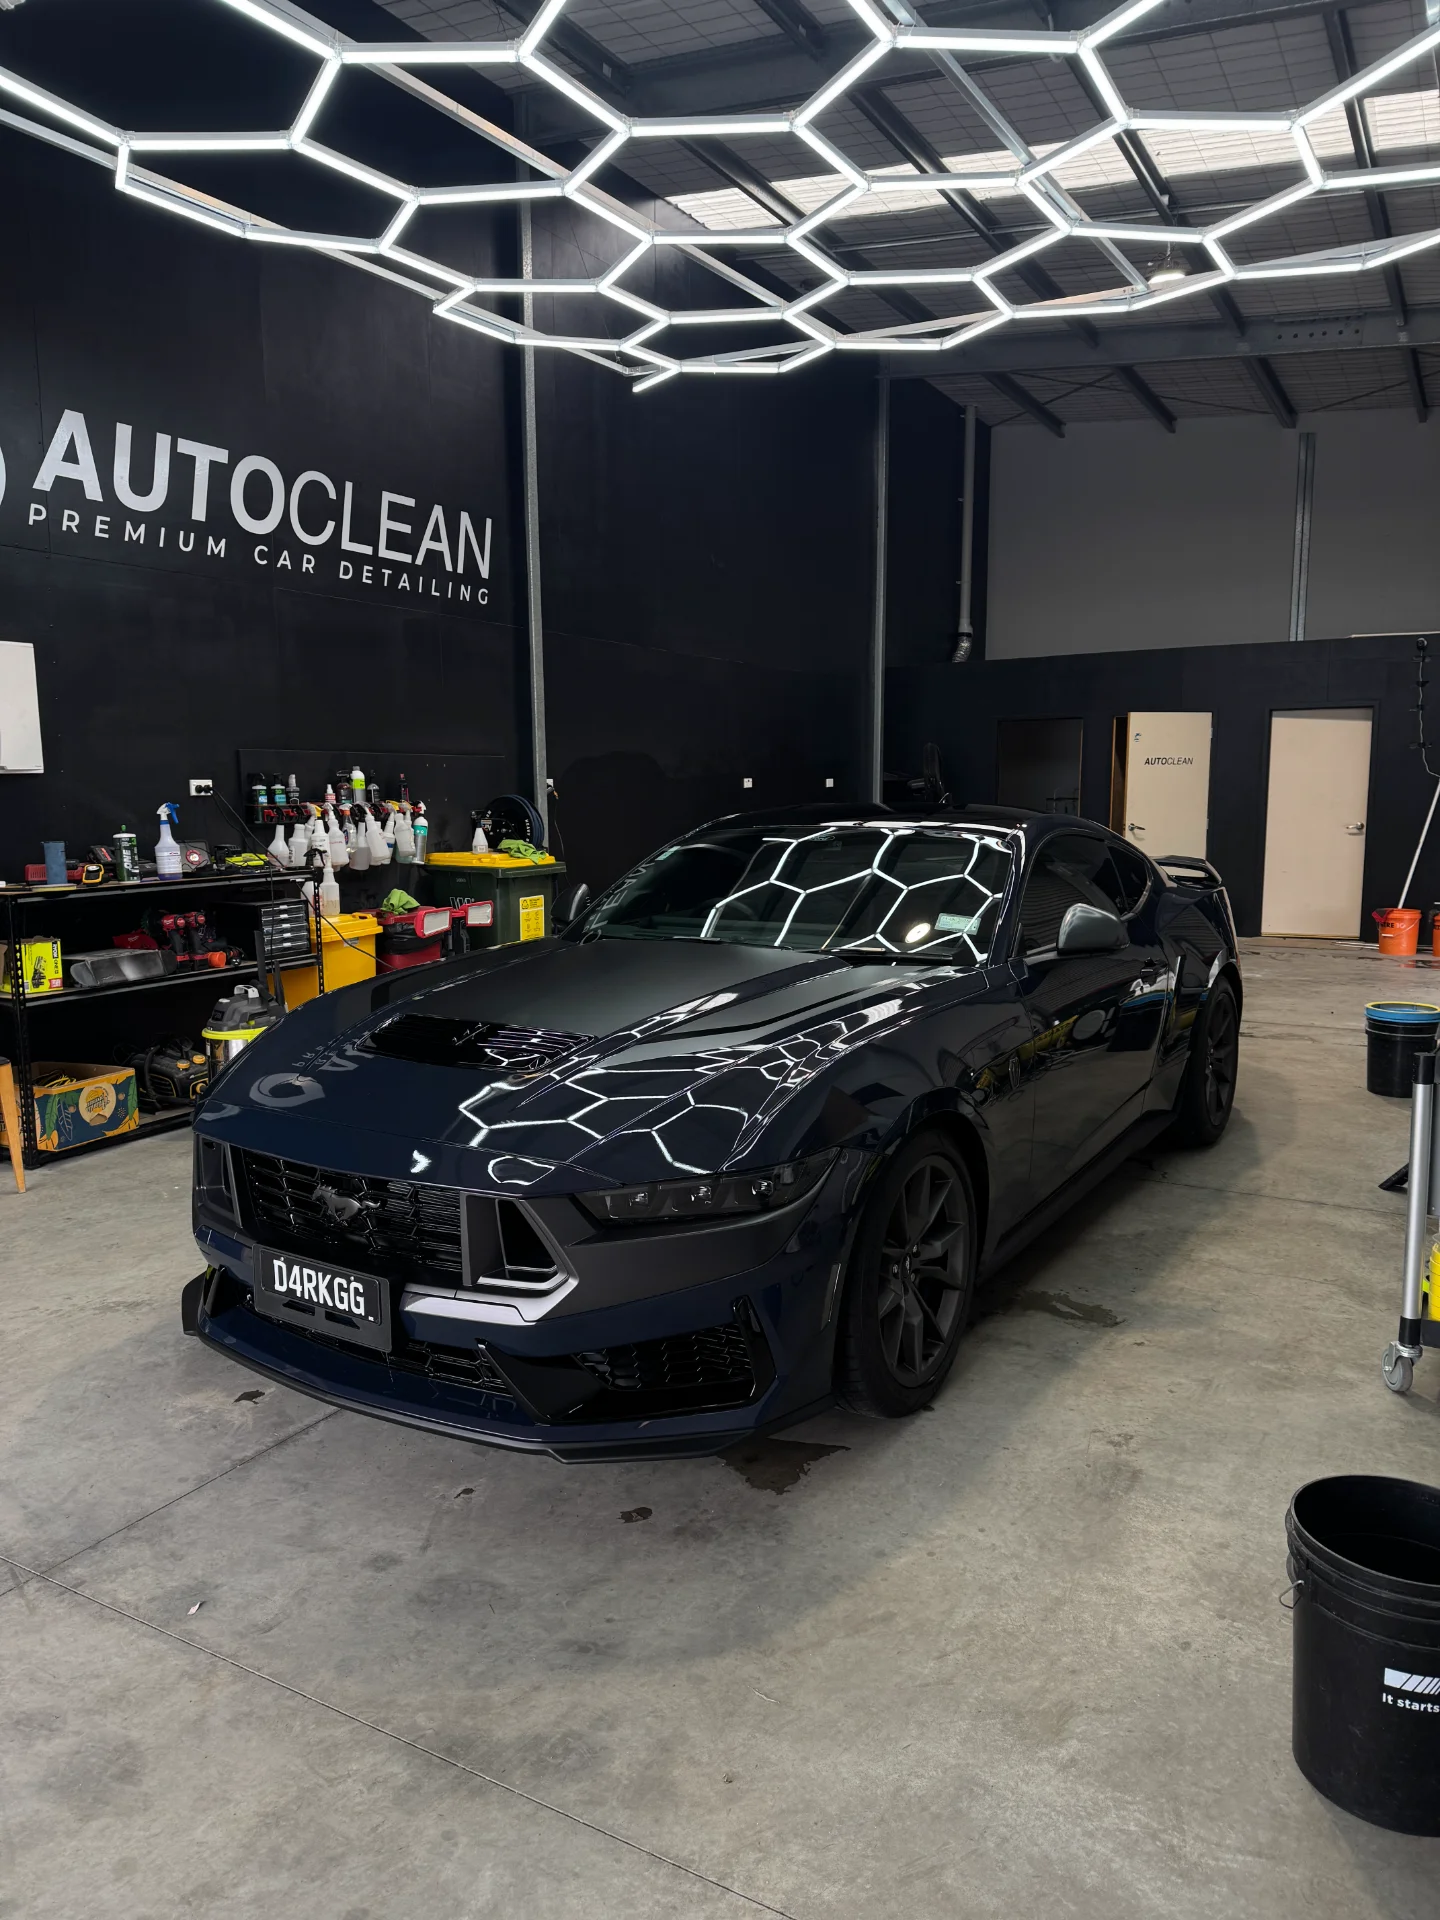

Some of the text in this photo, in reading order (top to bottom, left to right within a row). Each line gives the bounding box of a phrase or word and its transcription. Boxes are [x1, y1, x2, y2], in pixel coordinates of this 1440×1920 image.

[32, 409, 492, 580] AUTOCLEAN
[28, 503, 489, 605] PREMIUM CAR DETAILING
[1144, 757, 1194, 766] AUTOCLEAN
[272, 1258, 365, 1317] D4RKGG
[1382, 1692, 1440, 1713] It starts
